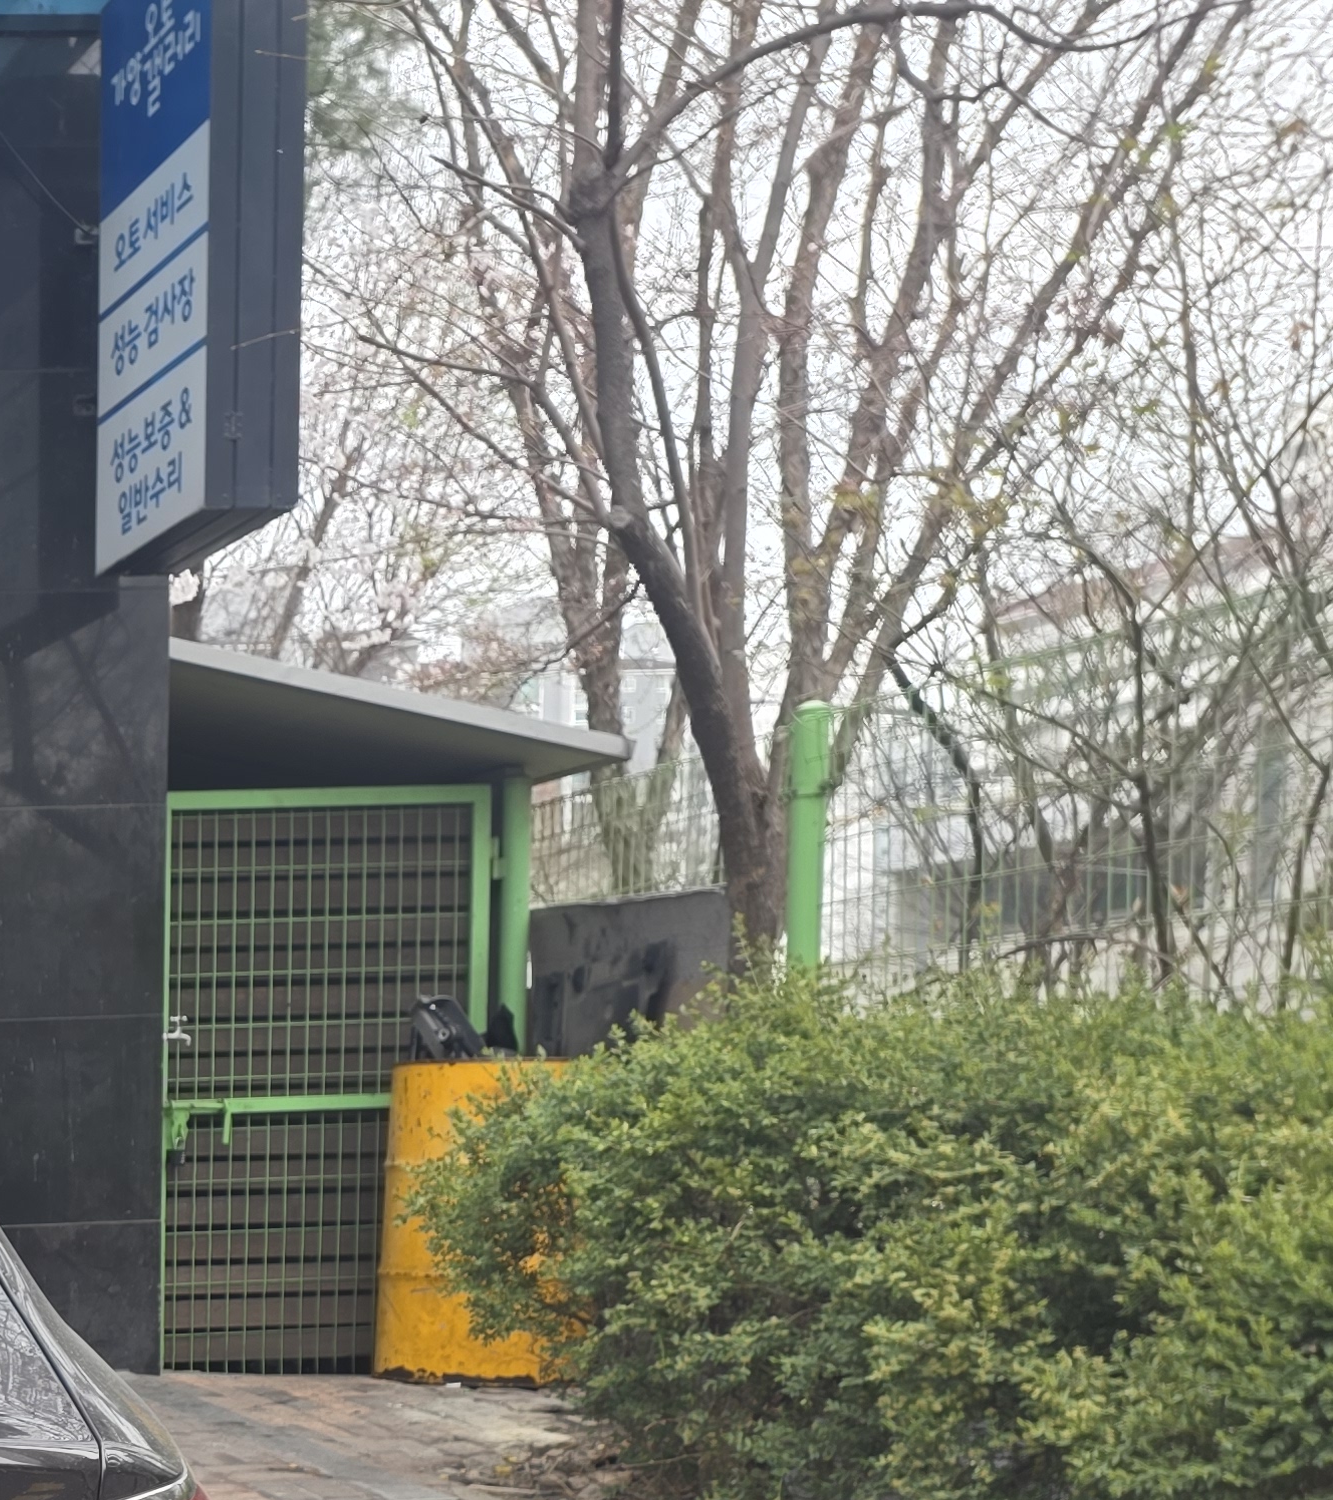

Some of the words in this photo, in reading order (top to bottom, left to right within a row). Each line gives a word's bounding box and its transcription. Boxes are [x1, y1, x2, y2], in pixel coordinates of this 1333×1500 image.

[144, 9, 201, 118] 갤러리
[110, 400, 175, 484] 성능보증
[178, 386, 193, 430] &
[118, 451, 184, 536] 일반수리
